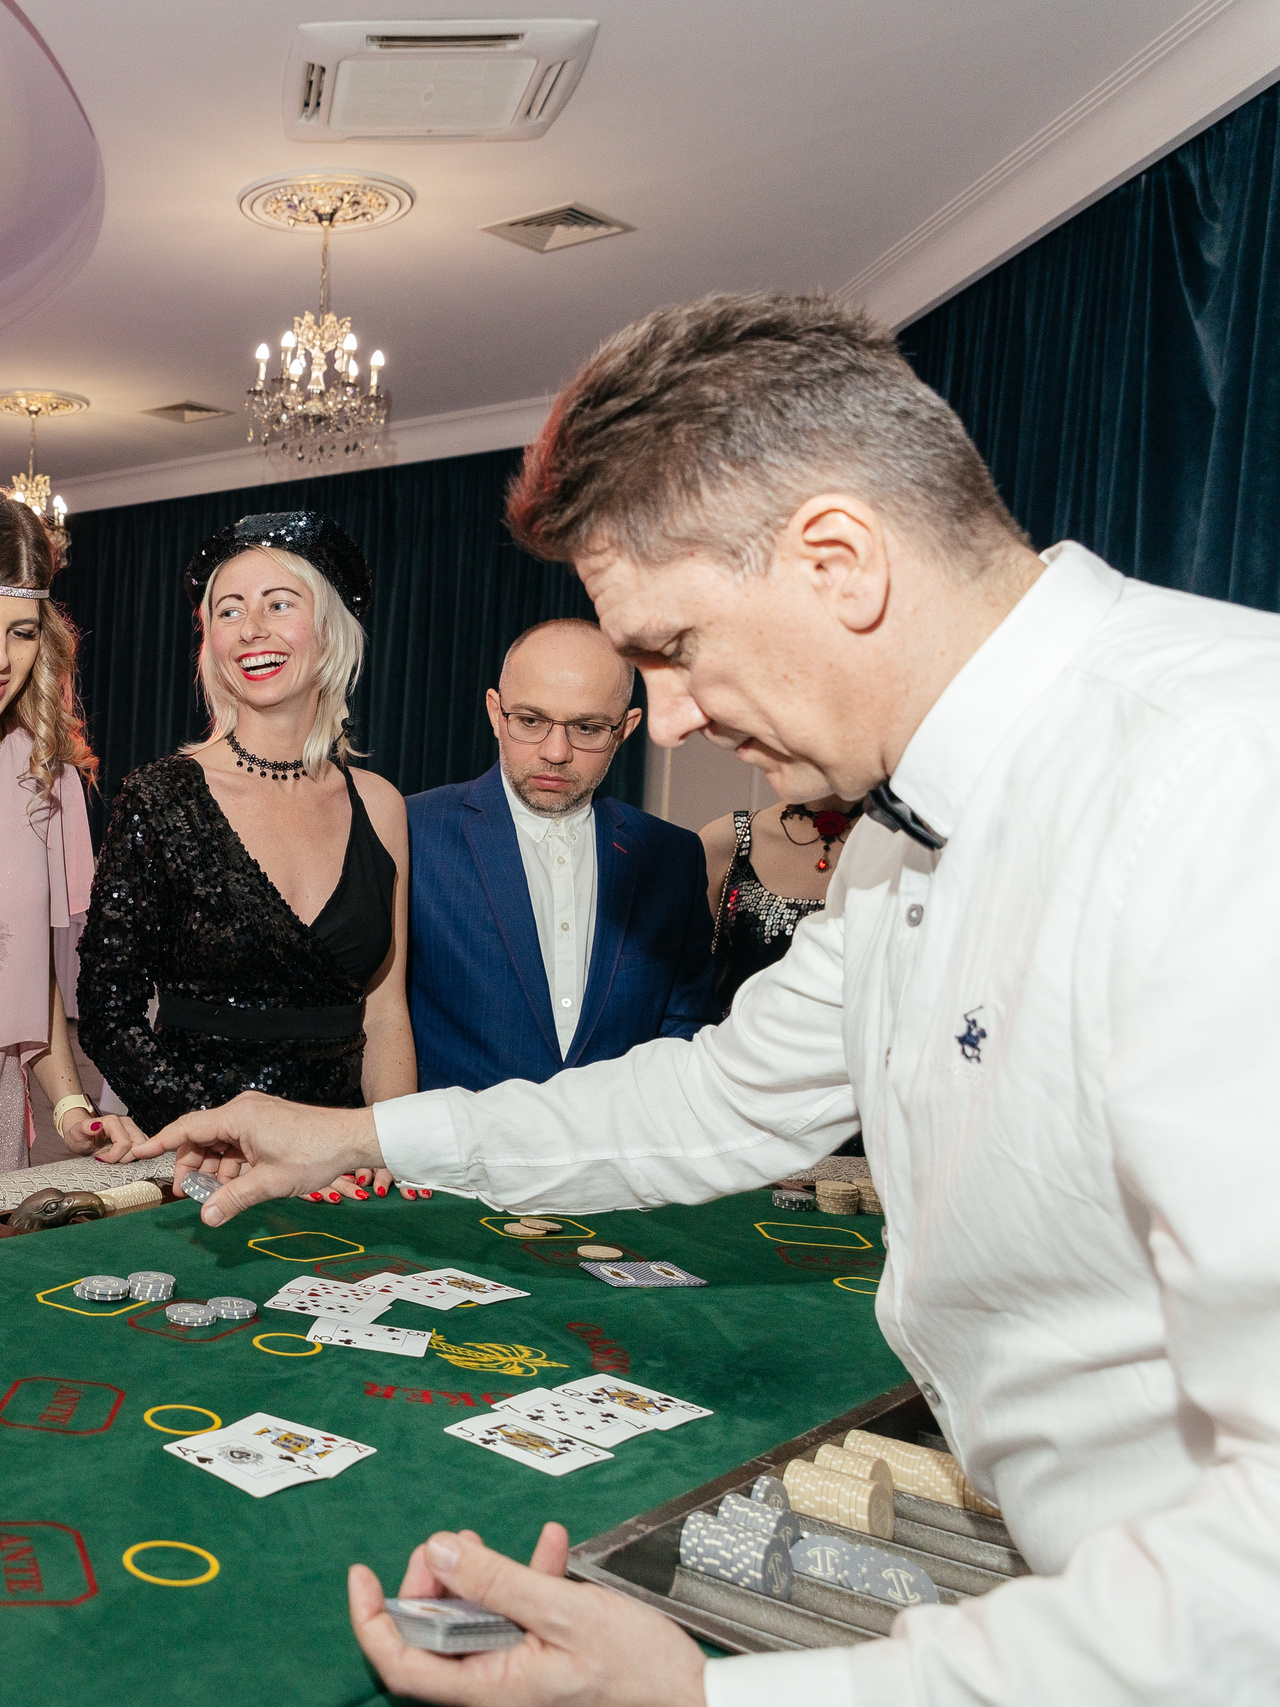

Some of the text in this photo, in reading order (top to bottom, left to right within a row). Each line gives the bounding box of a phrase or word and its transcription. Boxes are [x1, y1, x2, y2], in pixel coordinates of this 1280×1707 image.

[284, 1287, 305, 1296] 10
[270, 1300, 290, 1308] 10
[313, 1334, 333, 1342] 3
[363, 1381, 515, 1408] OKER
[562, 1388, 589, 1397] Q
[500, 1404, 521, 1413] 7
[624, 1419, 647, 1429] 7
[457, 1426, 475, 1438] J
[176, 1446, 197, 1456] A
[581, 1446, 601, 1457] J
[295, 1464, 318, 1475] A
